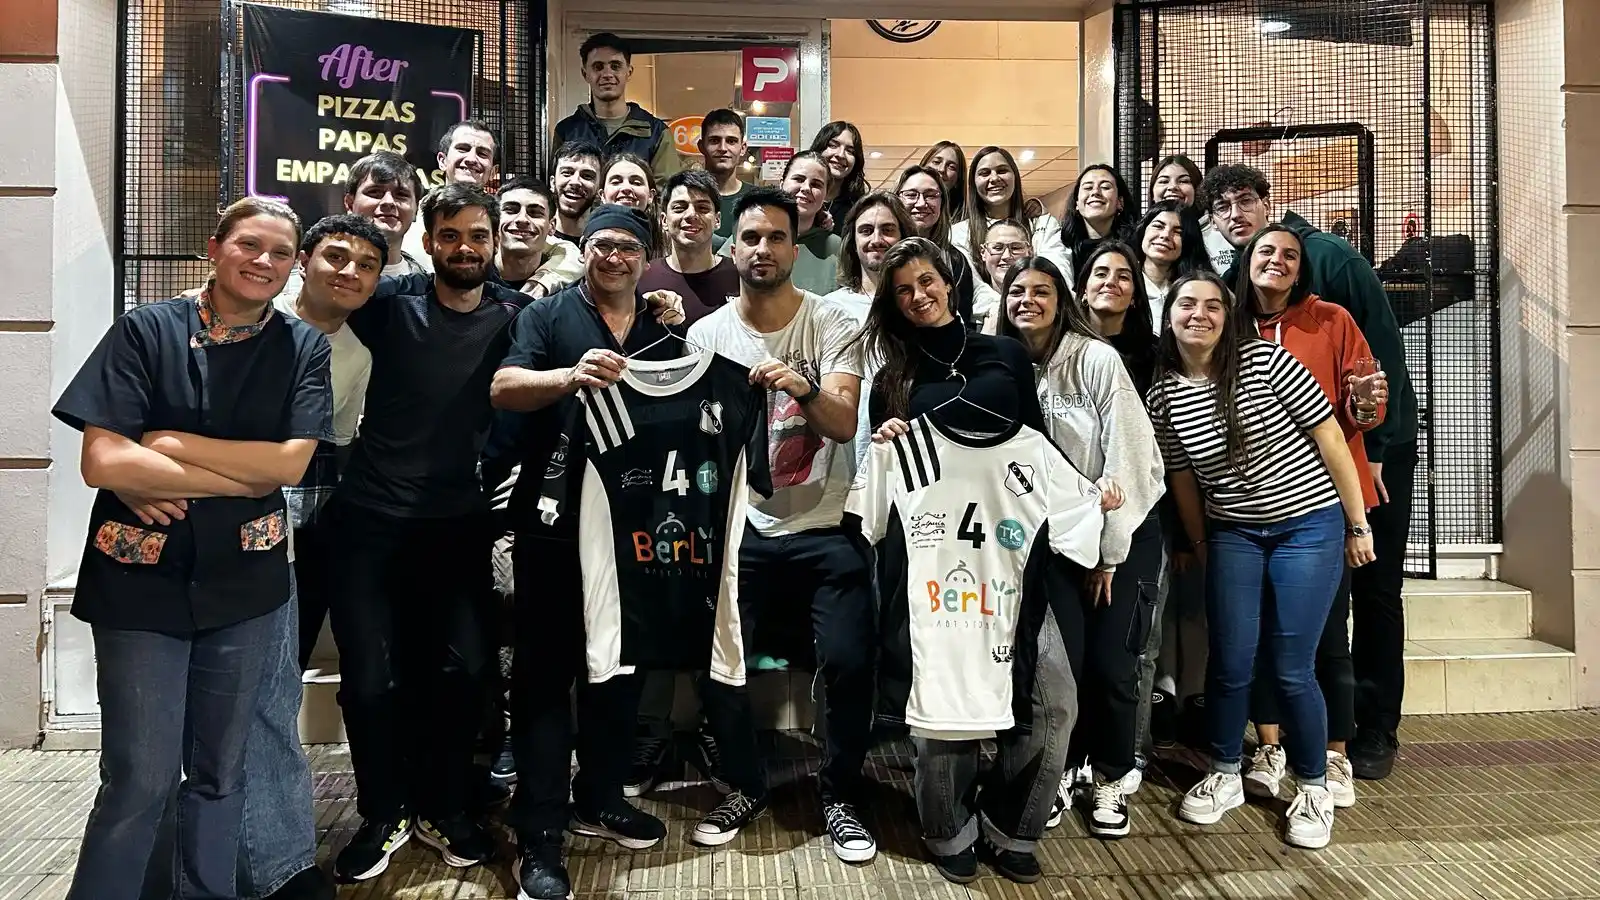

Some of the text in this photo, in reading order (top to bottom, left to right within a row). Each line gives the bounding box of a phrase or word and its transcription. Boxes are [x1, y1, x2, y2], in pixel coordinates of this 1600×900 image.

[318, 43, 409, 89] After
[317, 94, 416, 123] PIZZAS
[318, 127, 408, 156] PAPAS
[662, 450, 690, 496] 4
[699, 470, 719, 483] TK
[957, 502, 986, 549] 4
[1000, 525, 1021, 541] TK
[997, 645, 1009, 655] LT
